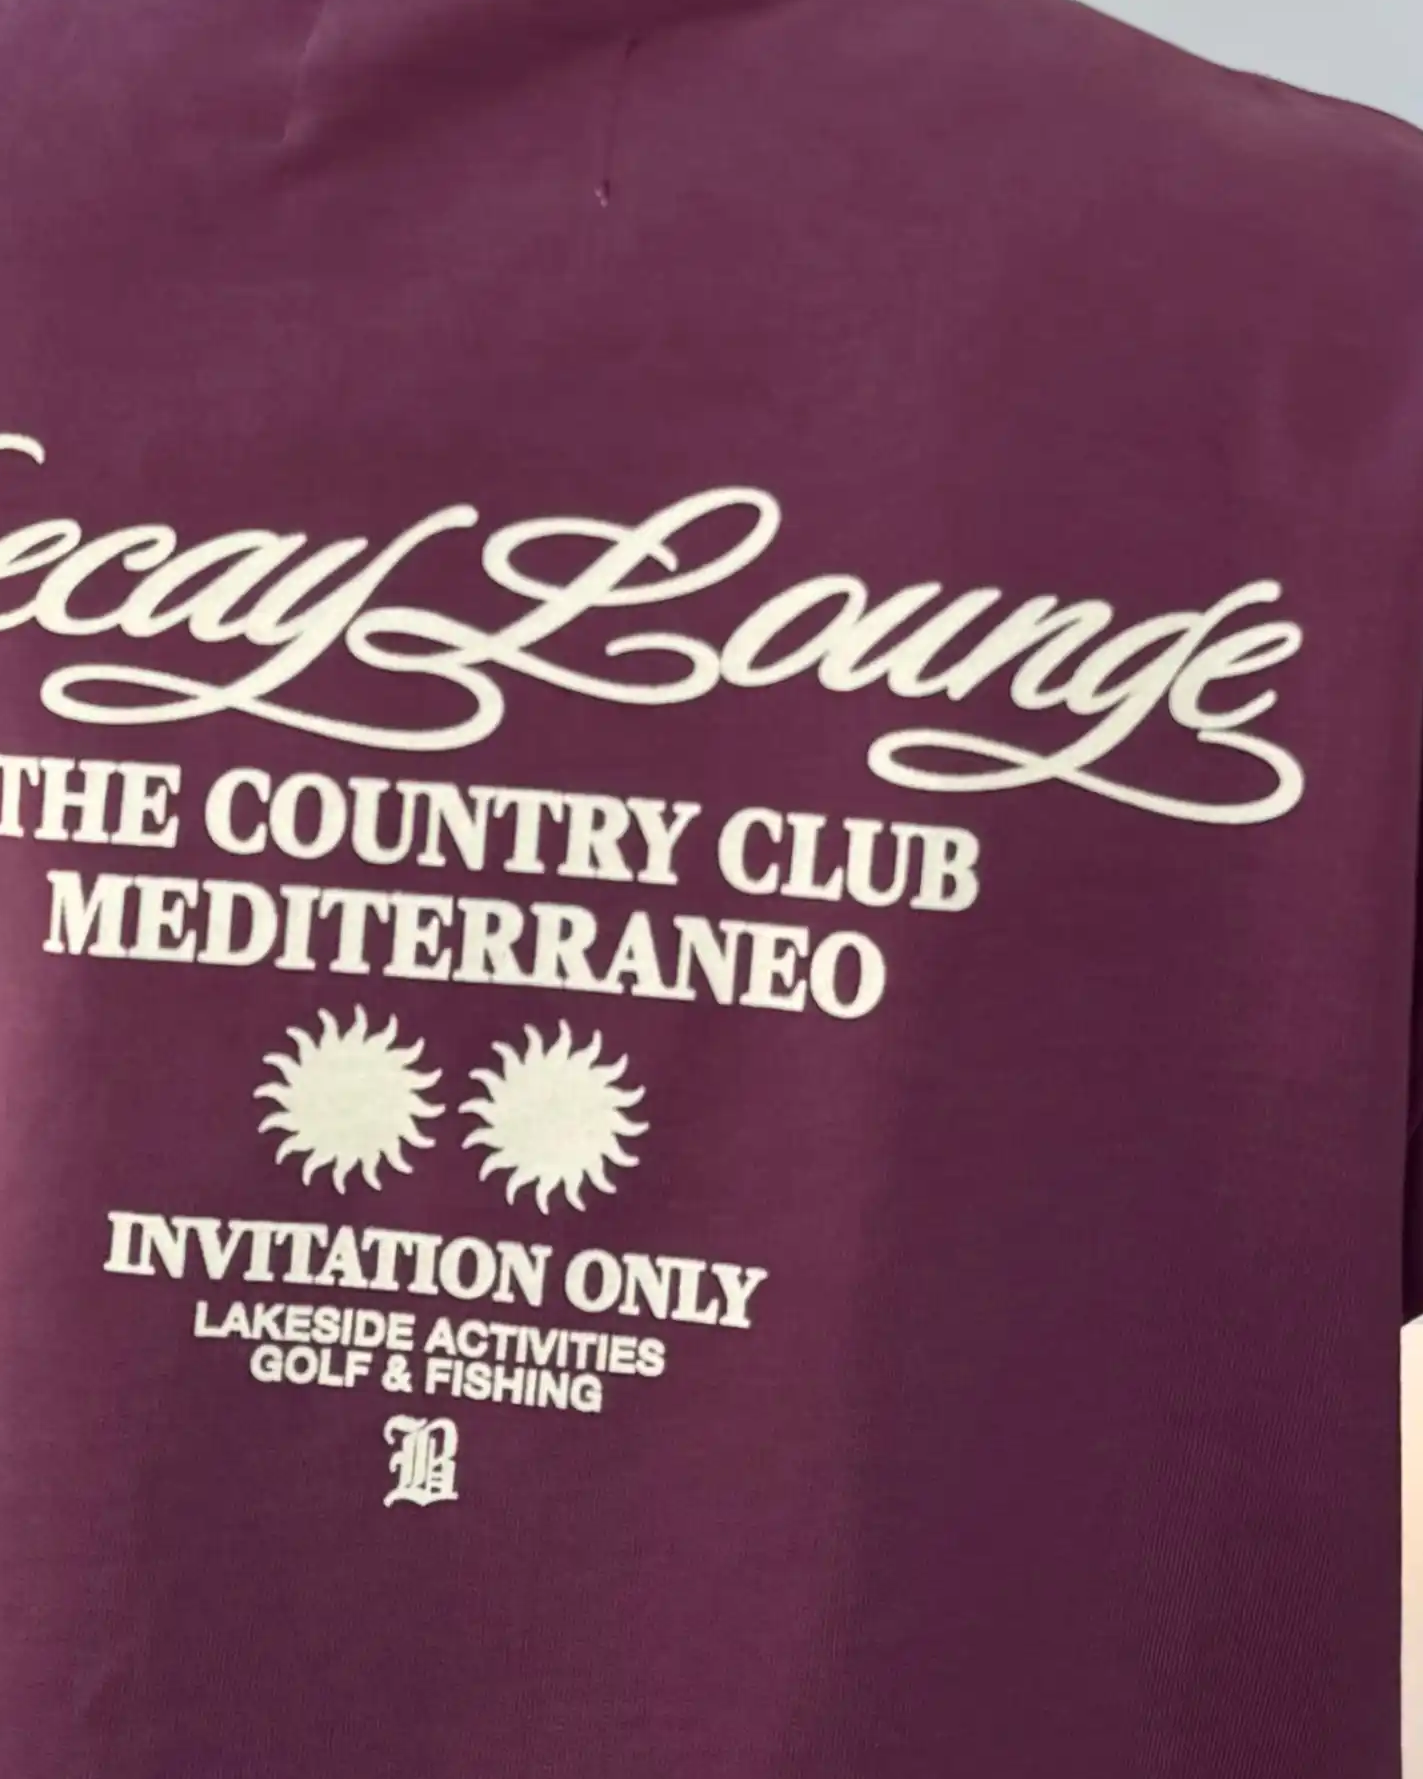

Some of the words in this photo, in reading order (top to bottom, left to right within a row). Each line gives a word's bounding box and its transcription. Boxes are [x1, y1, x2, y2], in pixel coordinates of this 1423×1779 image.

[346, 485, 1305, 826] Lounge
[204, 767, 702, 886] COUNTRY
[717, 806, 980, 912] CLUB
[41, 869, 887, 1020] MEDITERRANEO
[102, 1210, 554, 1308] INVITATION
[564, 1248, 769, 1330] ONLY
[193, 1300, 417, 1352] LAKESIDE
[423, 1316, 666, 1378] ACTIVITIES
[249, 1343, 374, 1389] GOLF
[380, 1353, 414, 1394] &
[424, 1356, 604, 1414] FISHING
